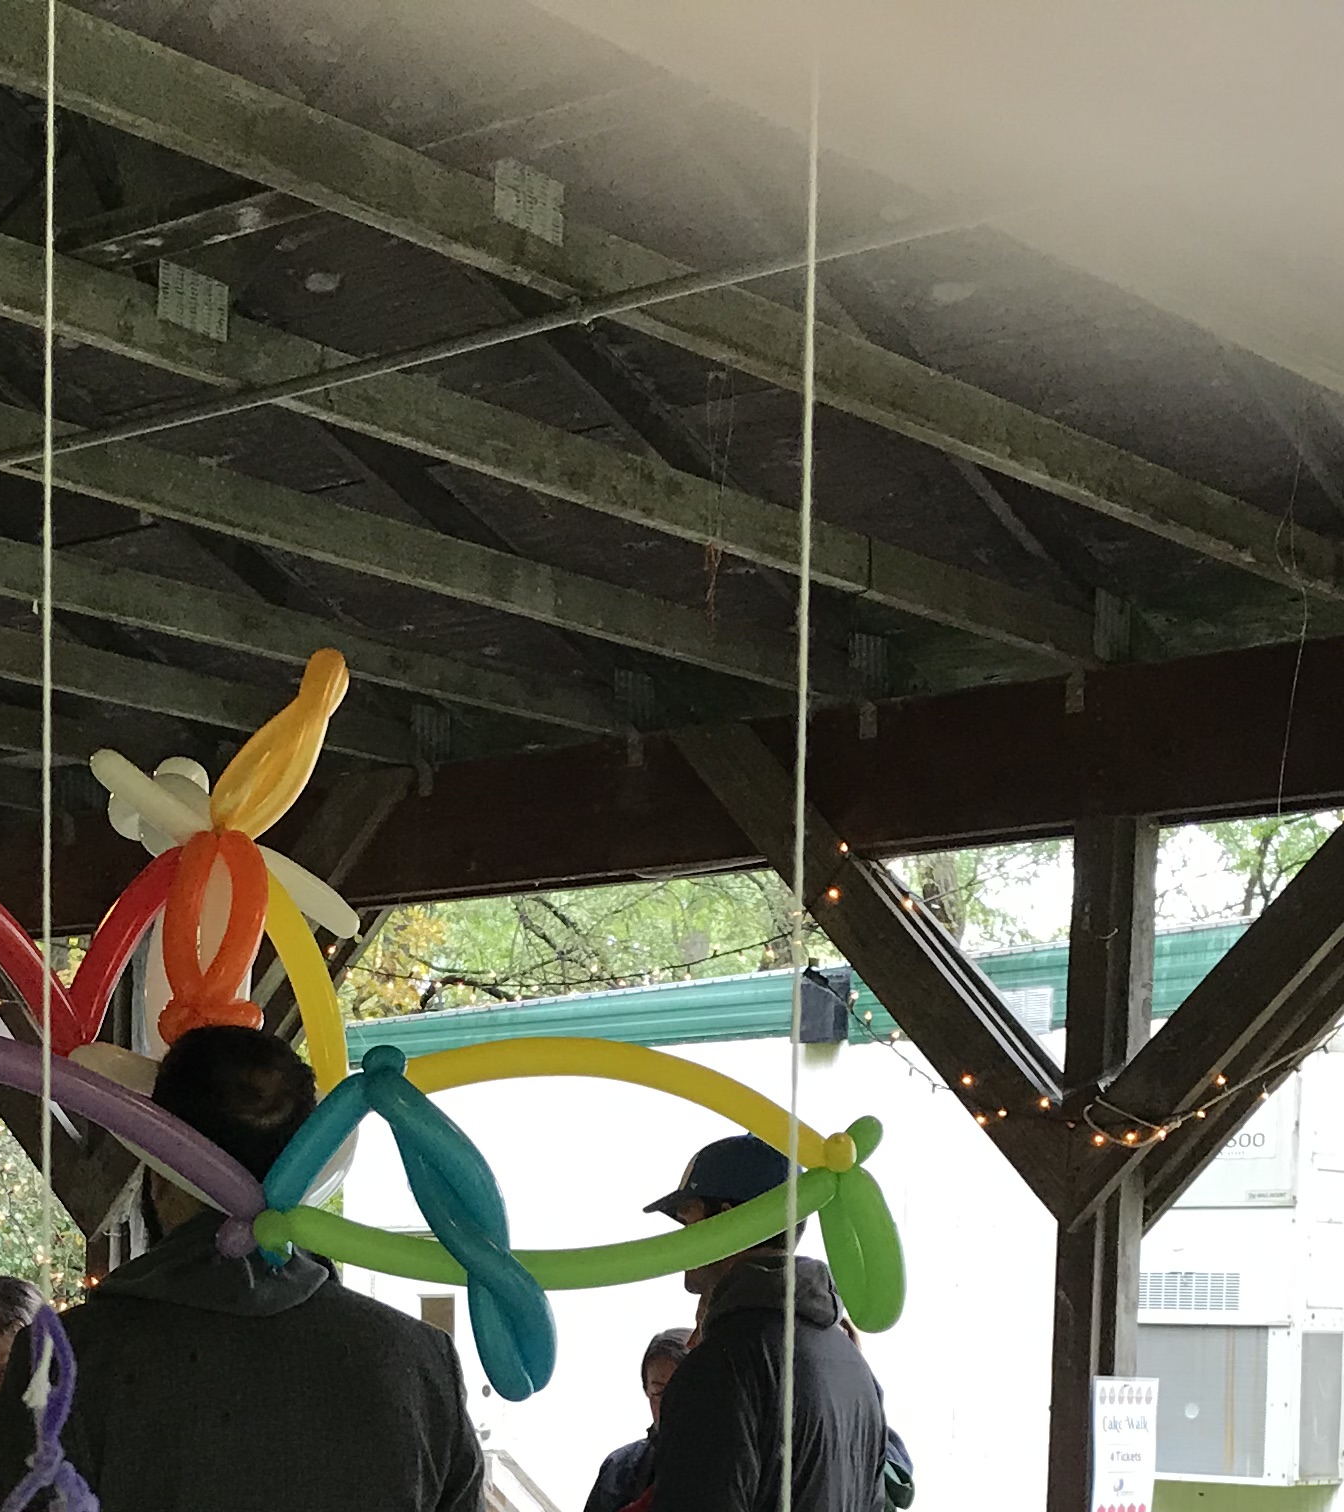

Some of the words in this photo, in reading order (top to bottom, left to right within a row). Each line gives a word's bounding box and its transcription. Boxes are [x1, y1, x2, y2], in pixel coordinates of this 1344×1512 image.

[1102, 1415, 1123, 1433] Cake
[1124, 1415, 1149, 1433] Walk
[1116, 1451, 1142, 1462] Tickets
